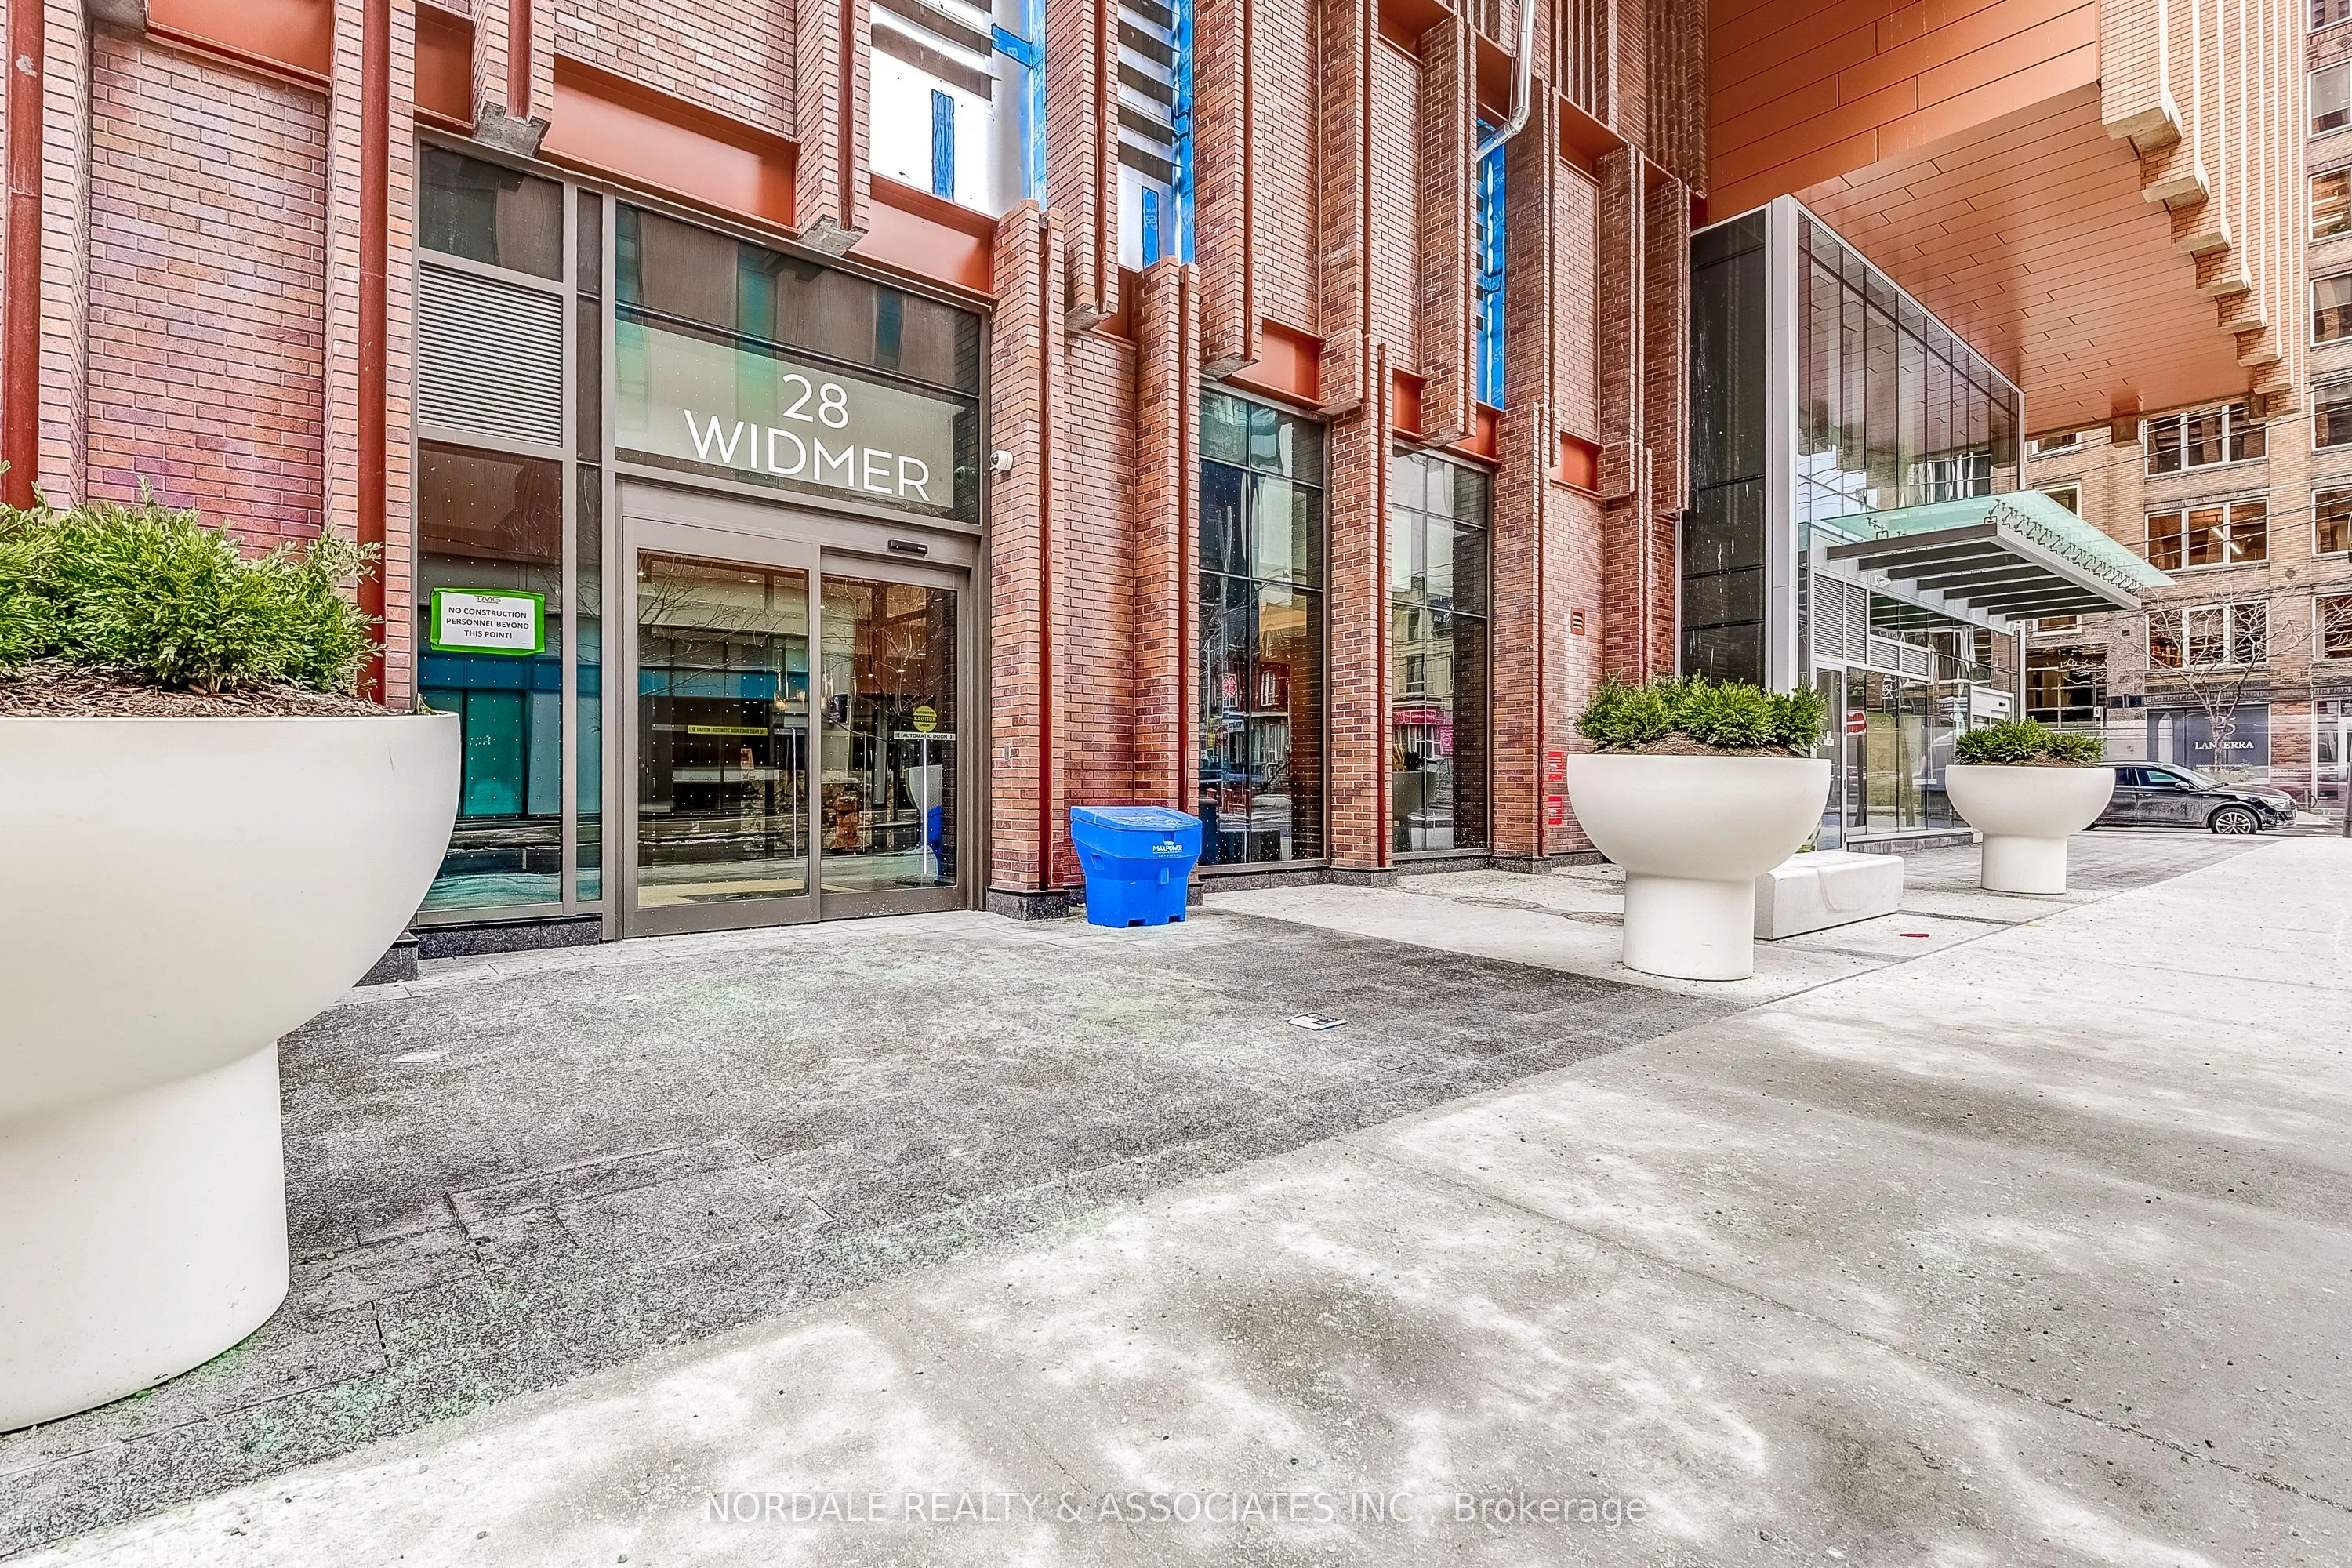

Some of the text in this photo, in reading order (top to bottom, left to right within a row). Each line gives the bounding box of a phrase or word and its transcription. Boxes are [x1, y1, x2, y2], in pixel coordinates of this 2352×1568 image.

[782, 373, 850, 430] 28
[683, 408, 931, 502] WIDMER
[463, 608, 527, 619] CONSTRUCTION
[446, 618, 529, 630] PERSONNEL BEYOND
[2195, 741, 2255, 750] LANERRA
